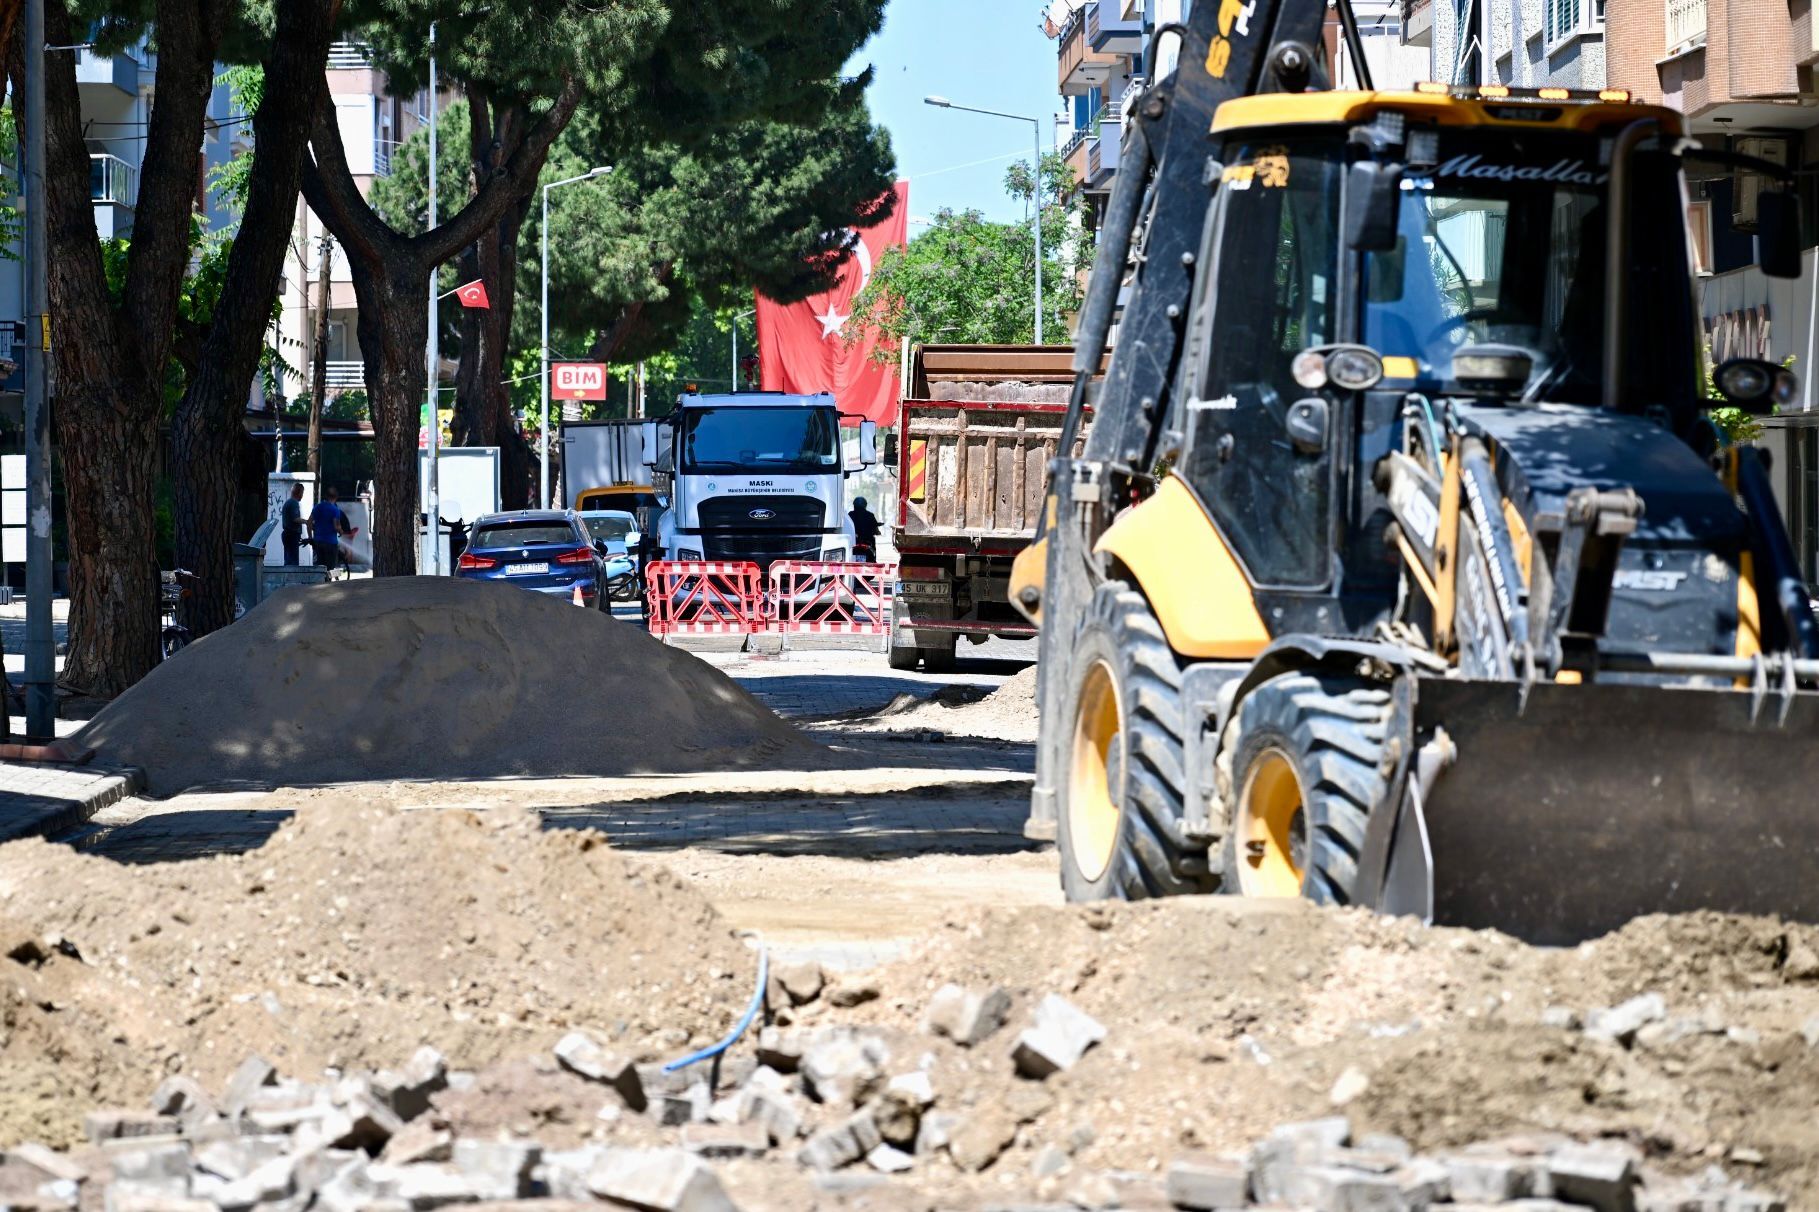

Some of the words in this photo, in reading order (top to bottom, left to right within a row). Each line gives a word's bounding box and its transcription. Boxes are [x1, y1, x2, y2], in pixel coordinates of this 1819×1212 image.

[1419, 154, 1608, 183] Maşalla
[901, 583, 912, 593] 45
[1611, 569, 1688, 590] MST
